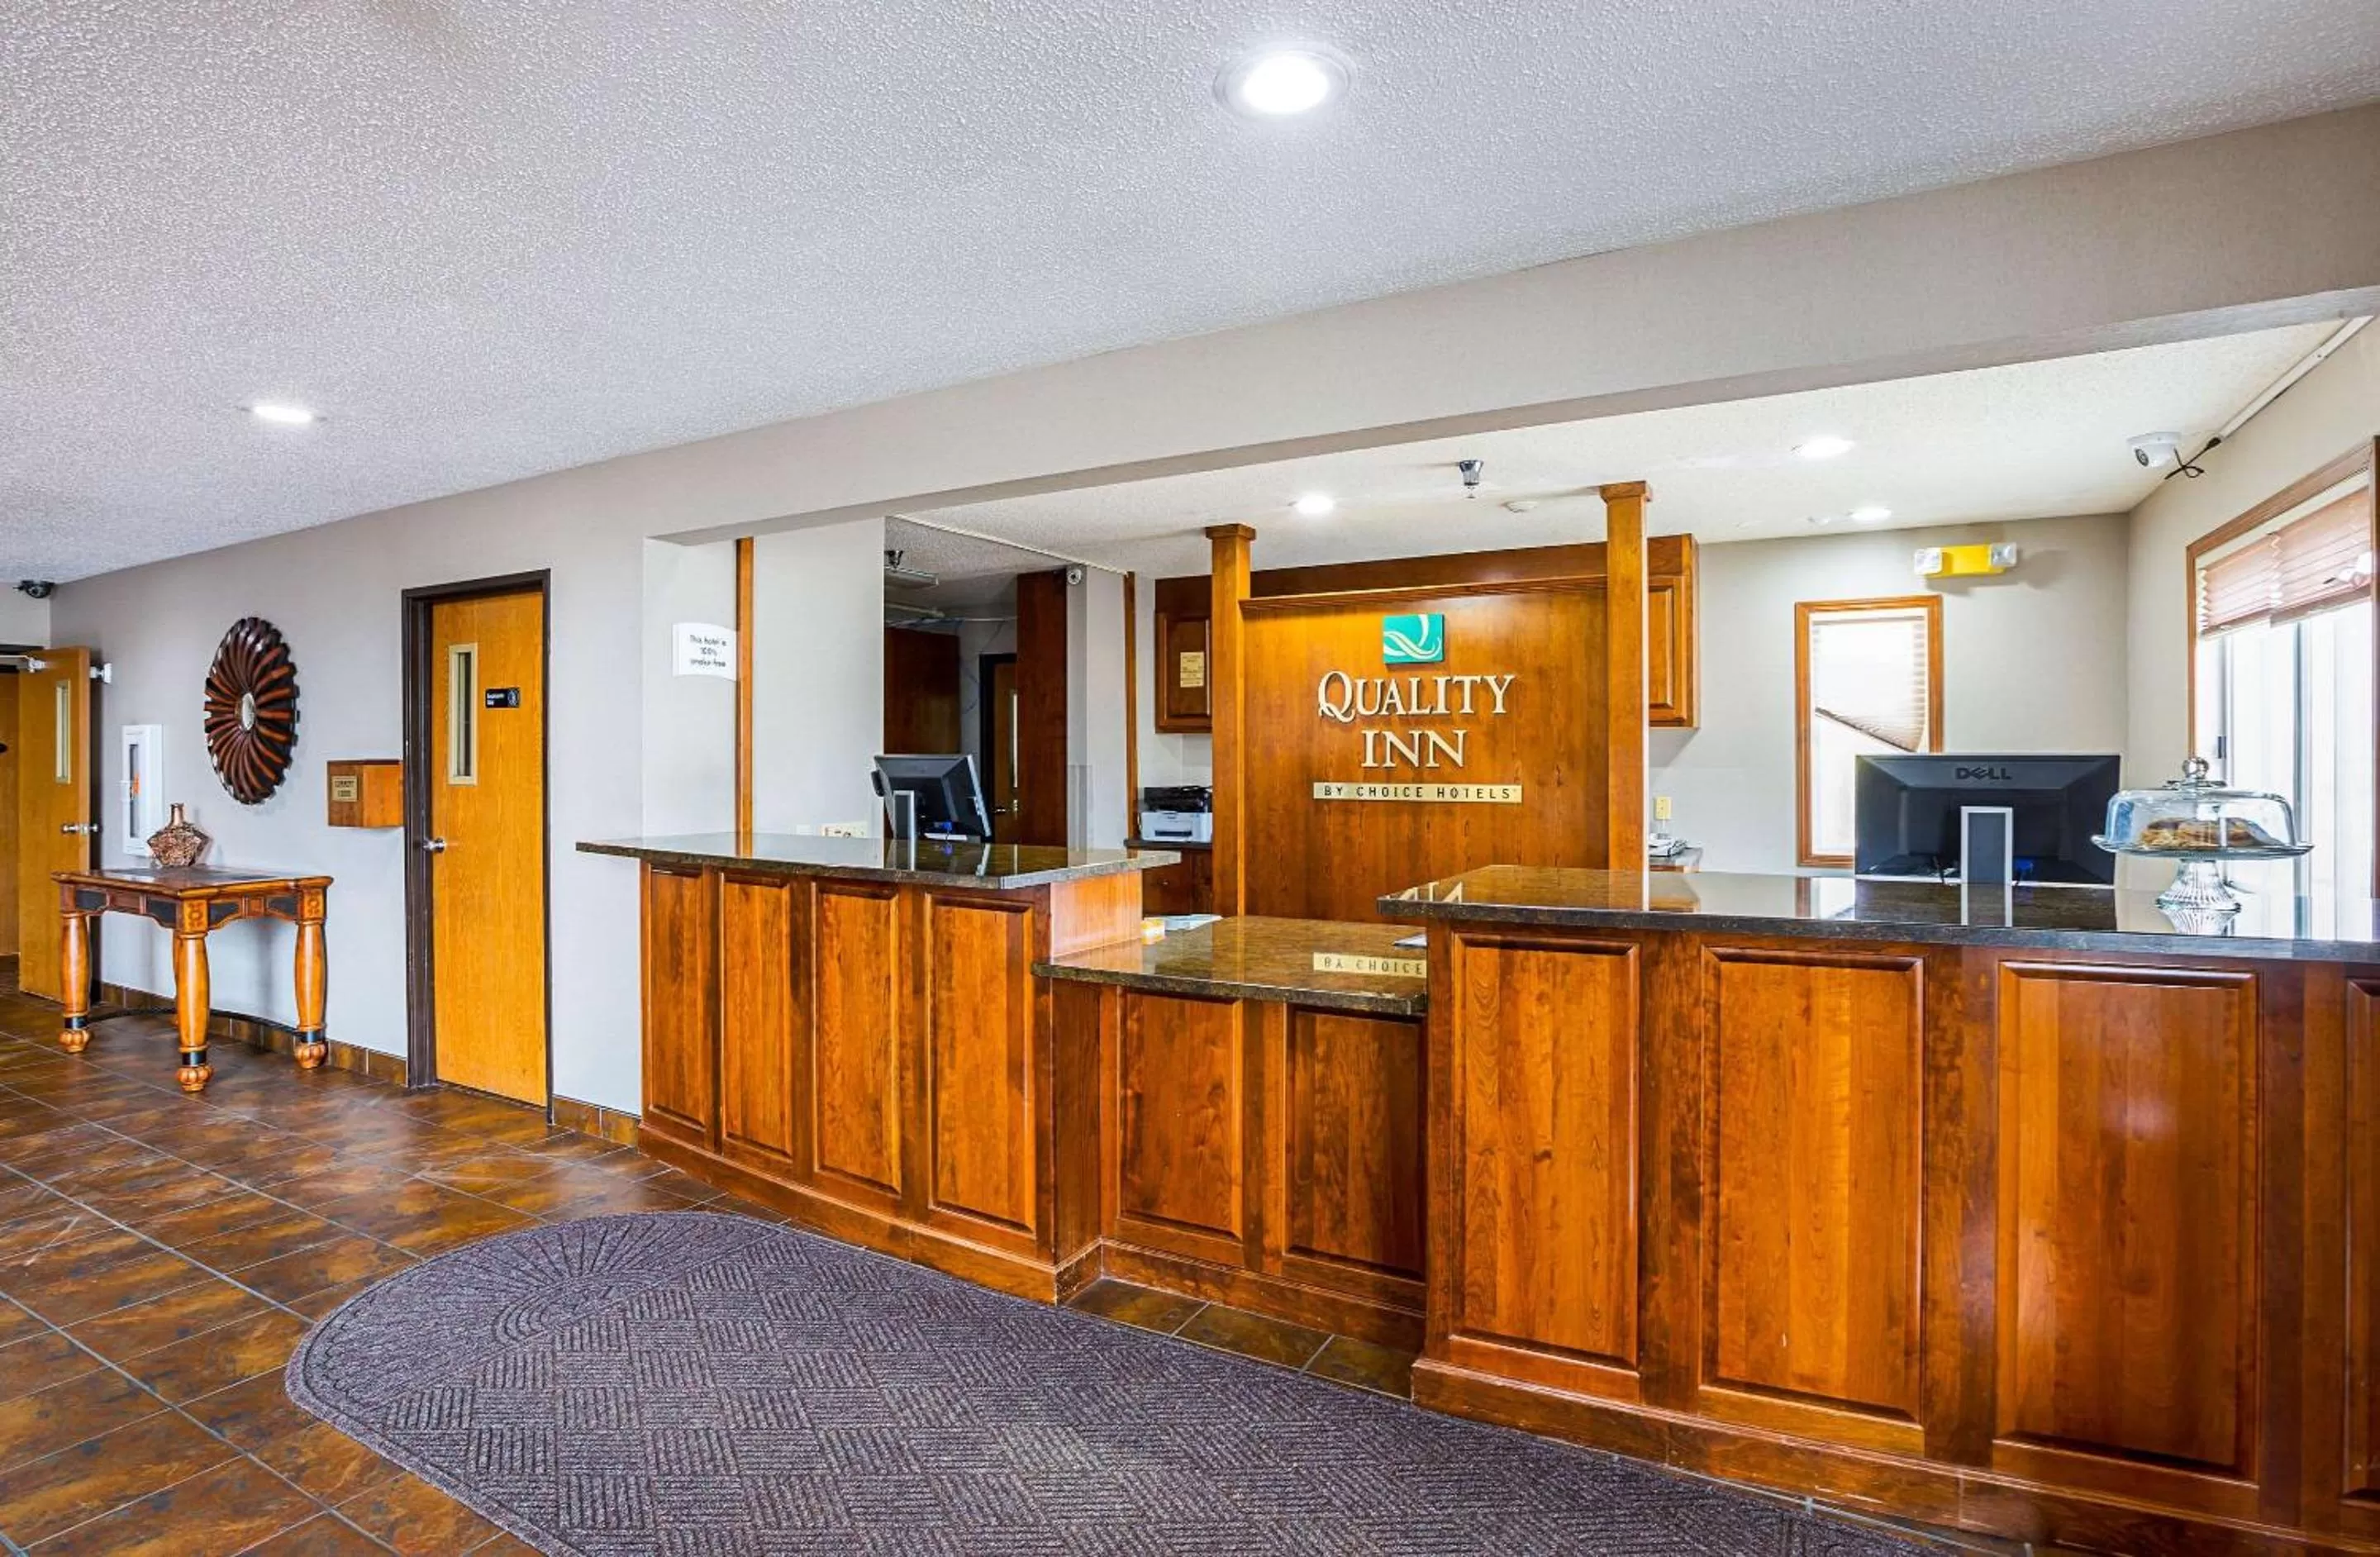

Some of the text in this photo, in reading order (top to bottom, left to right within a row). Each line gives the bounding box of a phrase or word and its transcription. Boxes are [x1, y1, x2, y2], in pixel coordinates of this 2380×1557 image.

[1317, 670, 1515, 722] QUALITY
[1360, 729, 1468, 768] INN
[1955, 766, 2012, 780] DELL
[1324, 785, 1512, 799] BY CHOICE HOTELS
